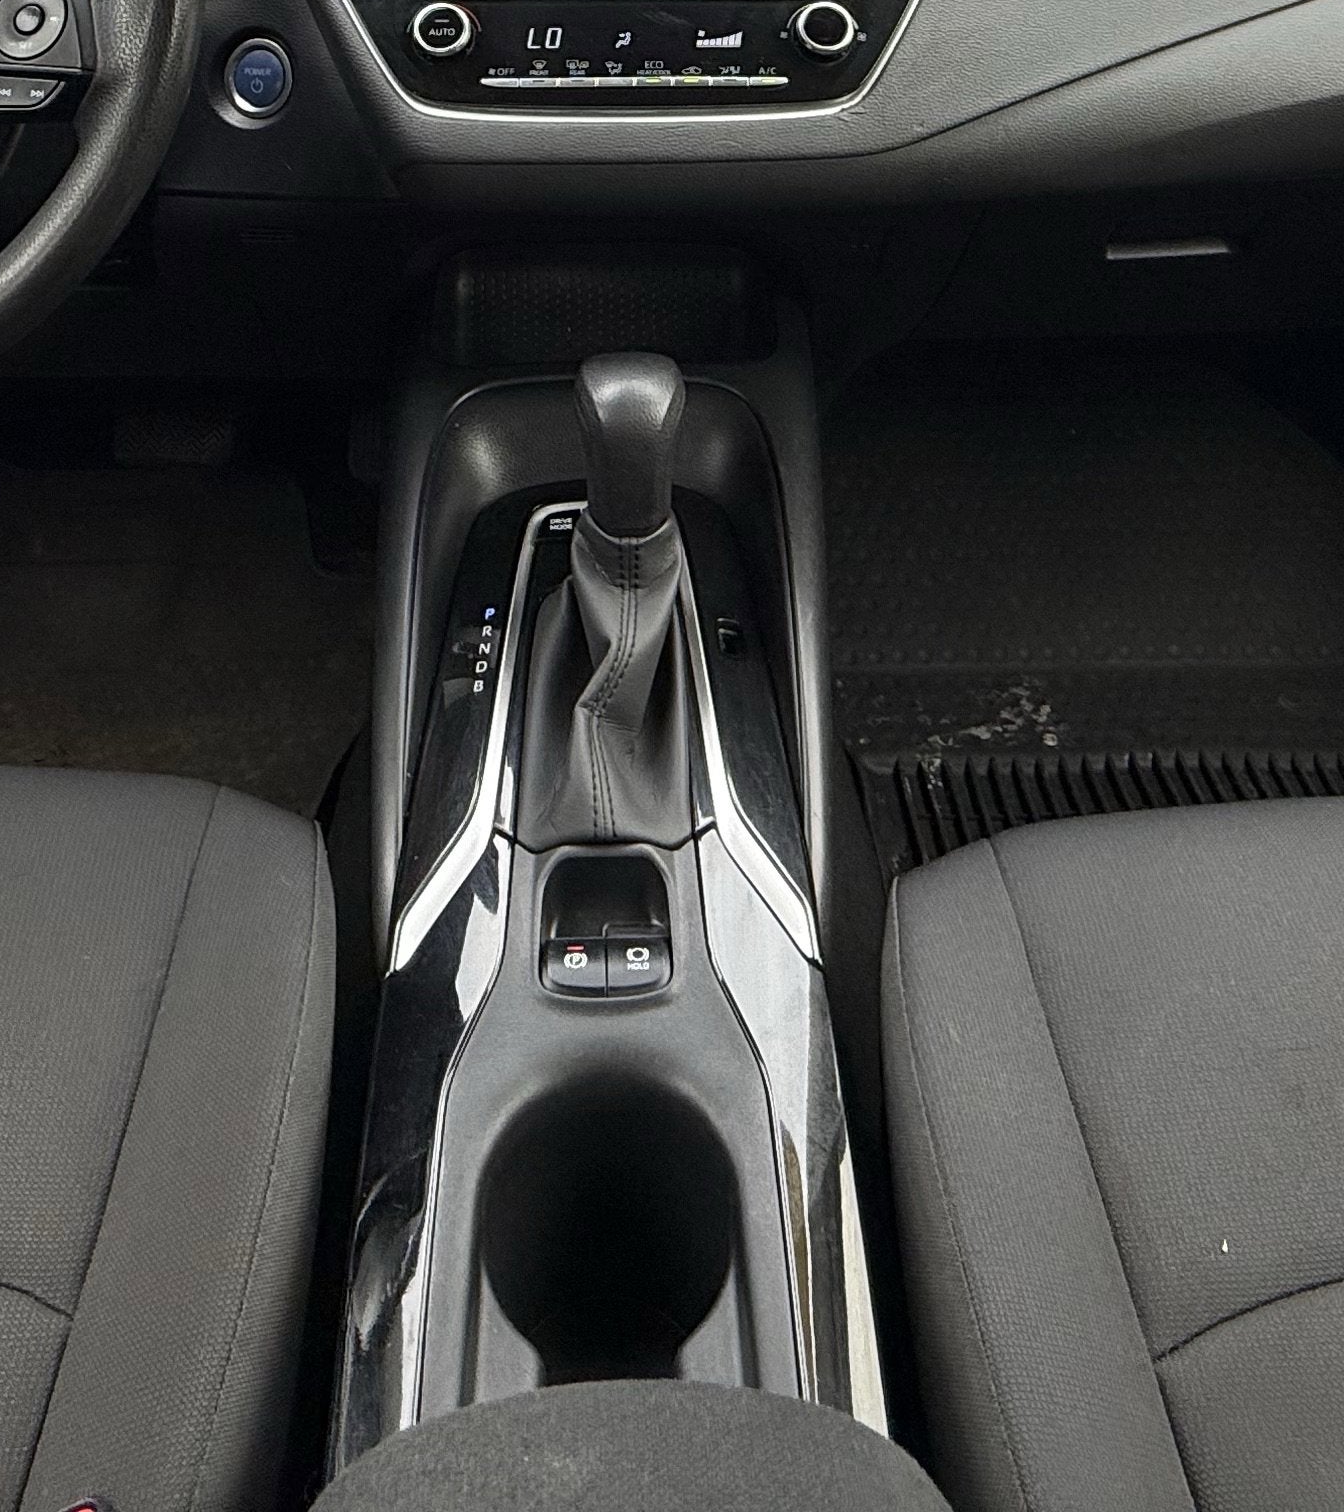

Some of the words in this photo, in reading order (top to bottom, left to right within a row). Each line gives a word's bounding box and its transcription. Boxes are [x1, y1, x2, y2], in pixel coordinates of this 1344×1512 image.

[429, 27, 455, 37] AUTO
[526, 27, 563, 50] LO
[644, 60, 664, 69] ECO
[244, 67, 272, 76] POWER
[496, 67, 516, 76] OFF
[758, 66, 777, 75] A/C
[549, 517, 573, 525] DRIVE
[484, 606, 496, 621] P
[481, 624, 493, 637] R
[478, 642, 491, 655] N
[475, 660, 488, 674] D
[473, 679, 485, 694] B
[627, 962, 650, 971] HOLD
